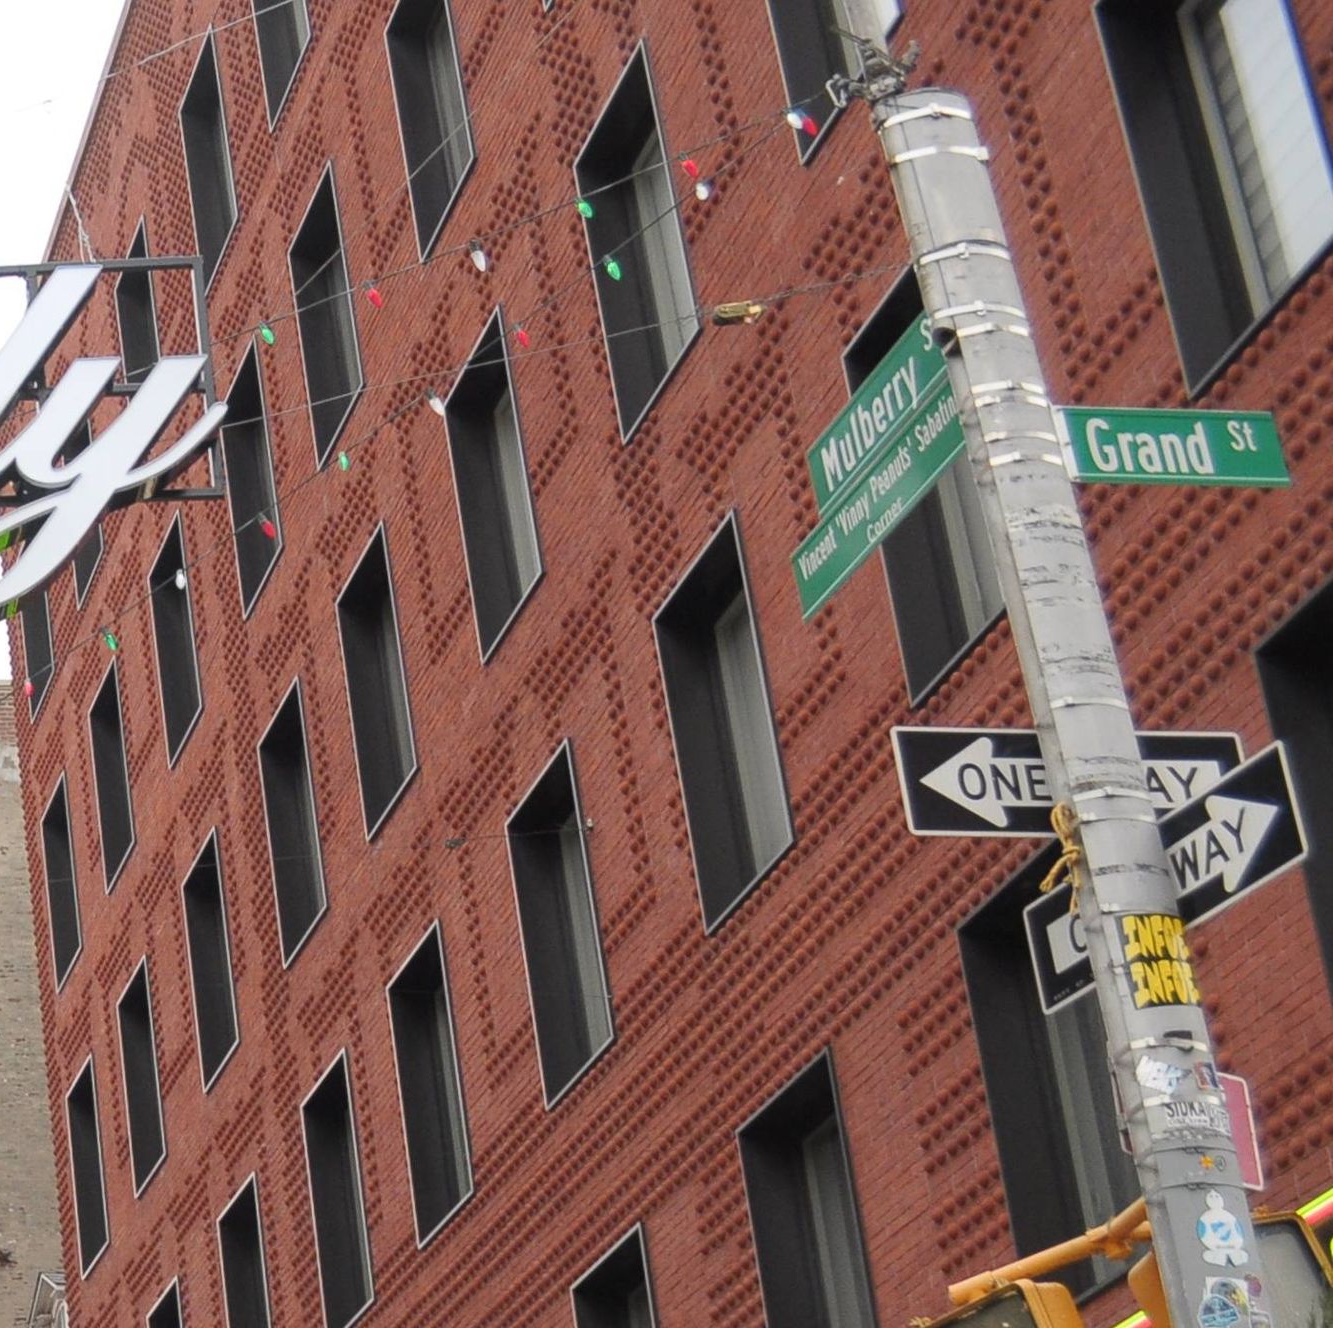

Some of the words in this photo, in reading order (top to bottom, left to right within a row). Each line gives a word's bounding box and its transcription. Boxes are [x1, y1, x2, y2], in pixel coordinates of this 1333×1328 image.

[820, 356, 919, 492] Mulberry
[919, 317, 933, 351] S
[1085, 417, 1215, 474] Grand
[1226, 420, 1257, 451] St
[798, 528, 837, 581] Vincent
[914, 395, 959, 453] Sabatin
[866, 496, 904, 544] Corner
[957, 762, 1047, 802] ONE
[1145, 765, 1199, 804] AY
[1170, 806, 1247, 891] WAY
